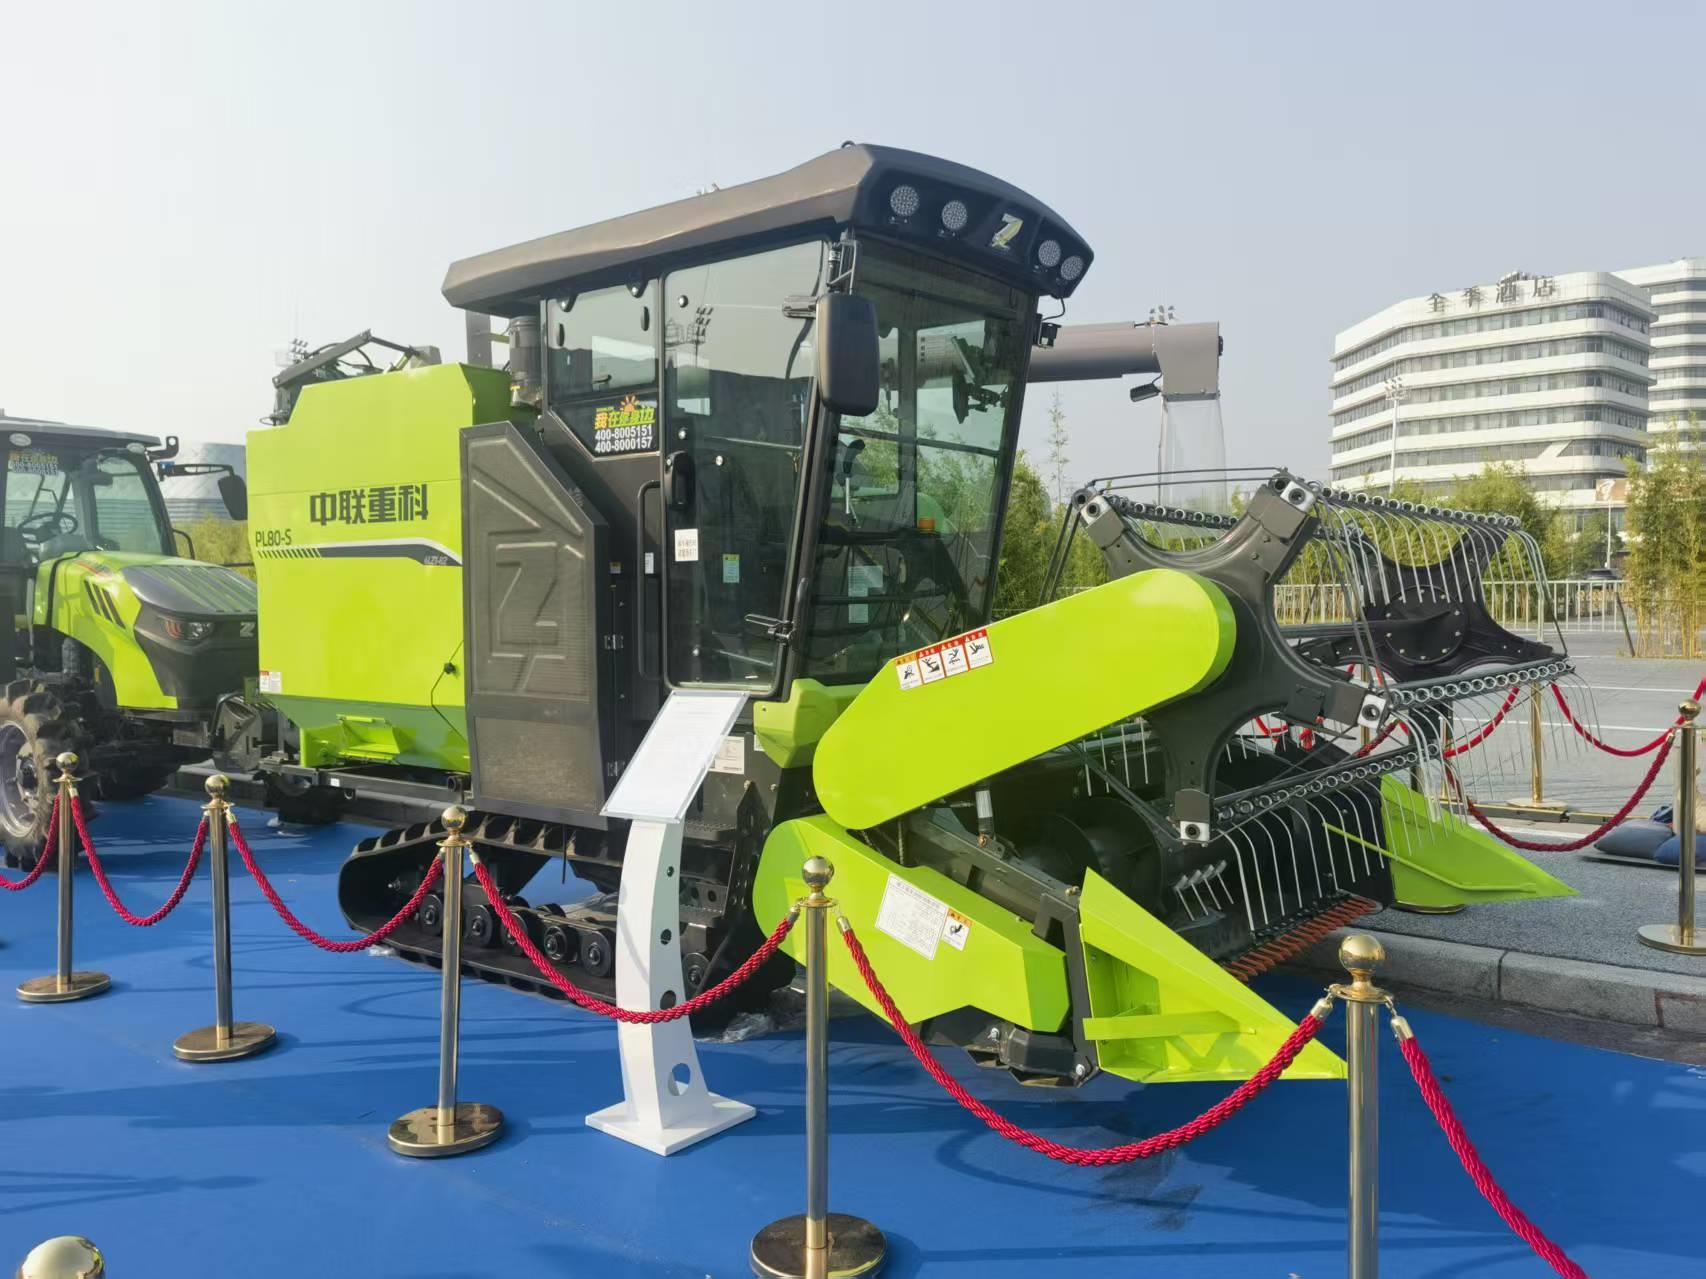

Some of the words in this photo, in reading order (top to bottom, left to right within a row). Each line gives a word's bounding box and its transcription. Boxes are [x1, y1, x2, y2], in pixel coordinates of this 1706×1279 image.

[1426, 277, 1555, 313] 全季酒店
[594, 424, 652, 441] 400-8005151
[594, 436, 653, 453] 400-8000157
[309, 483, 428, 526] 中联重科
[255, 528, 292, 547] PL80-S
